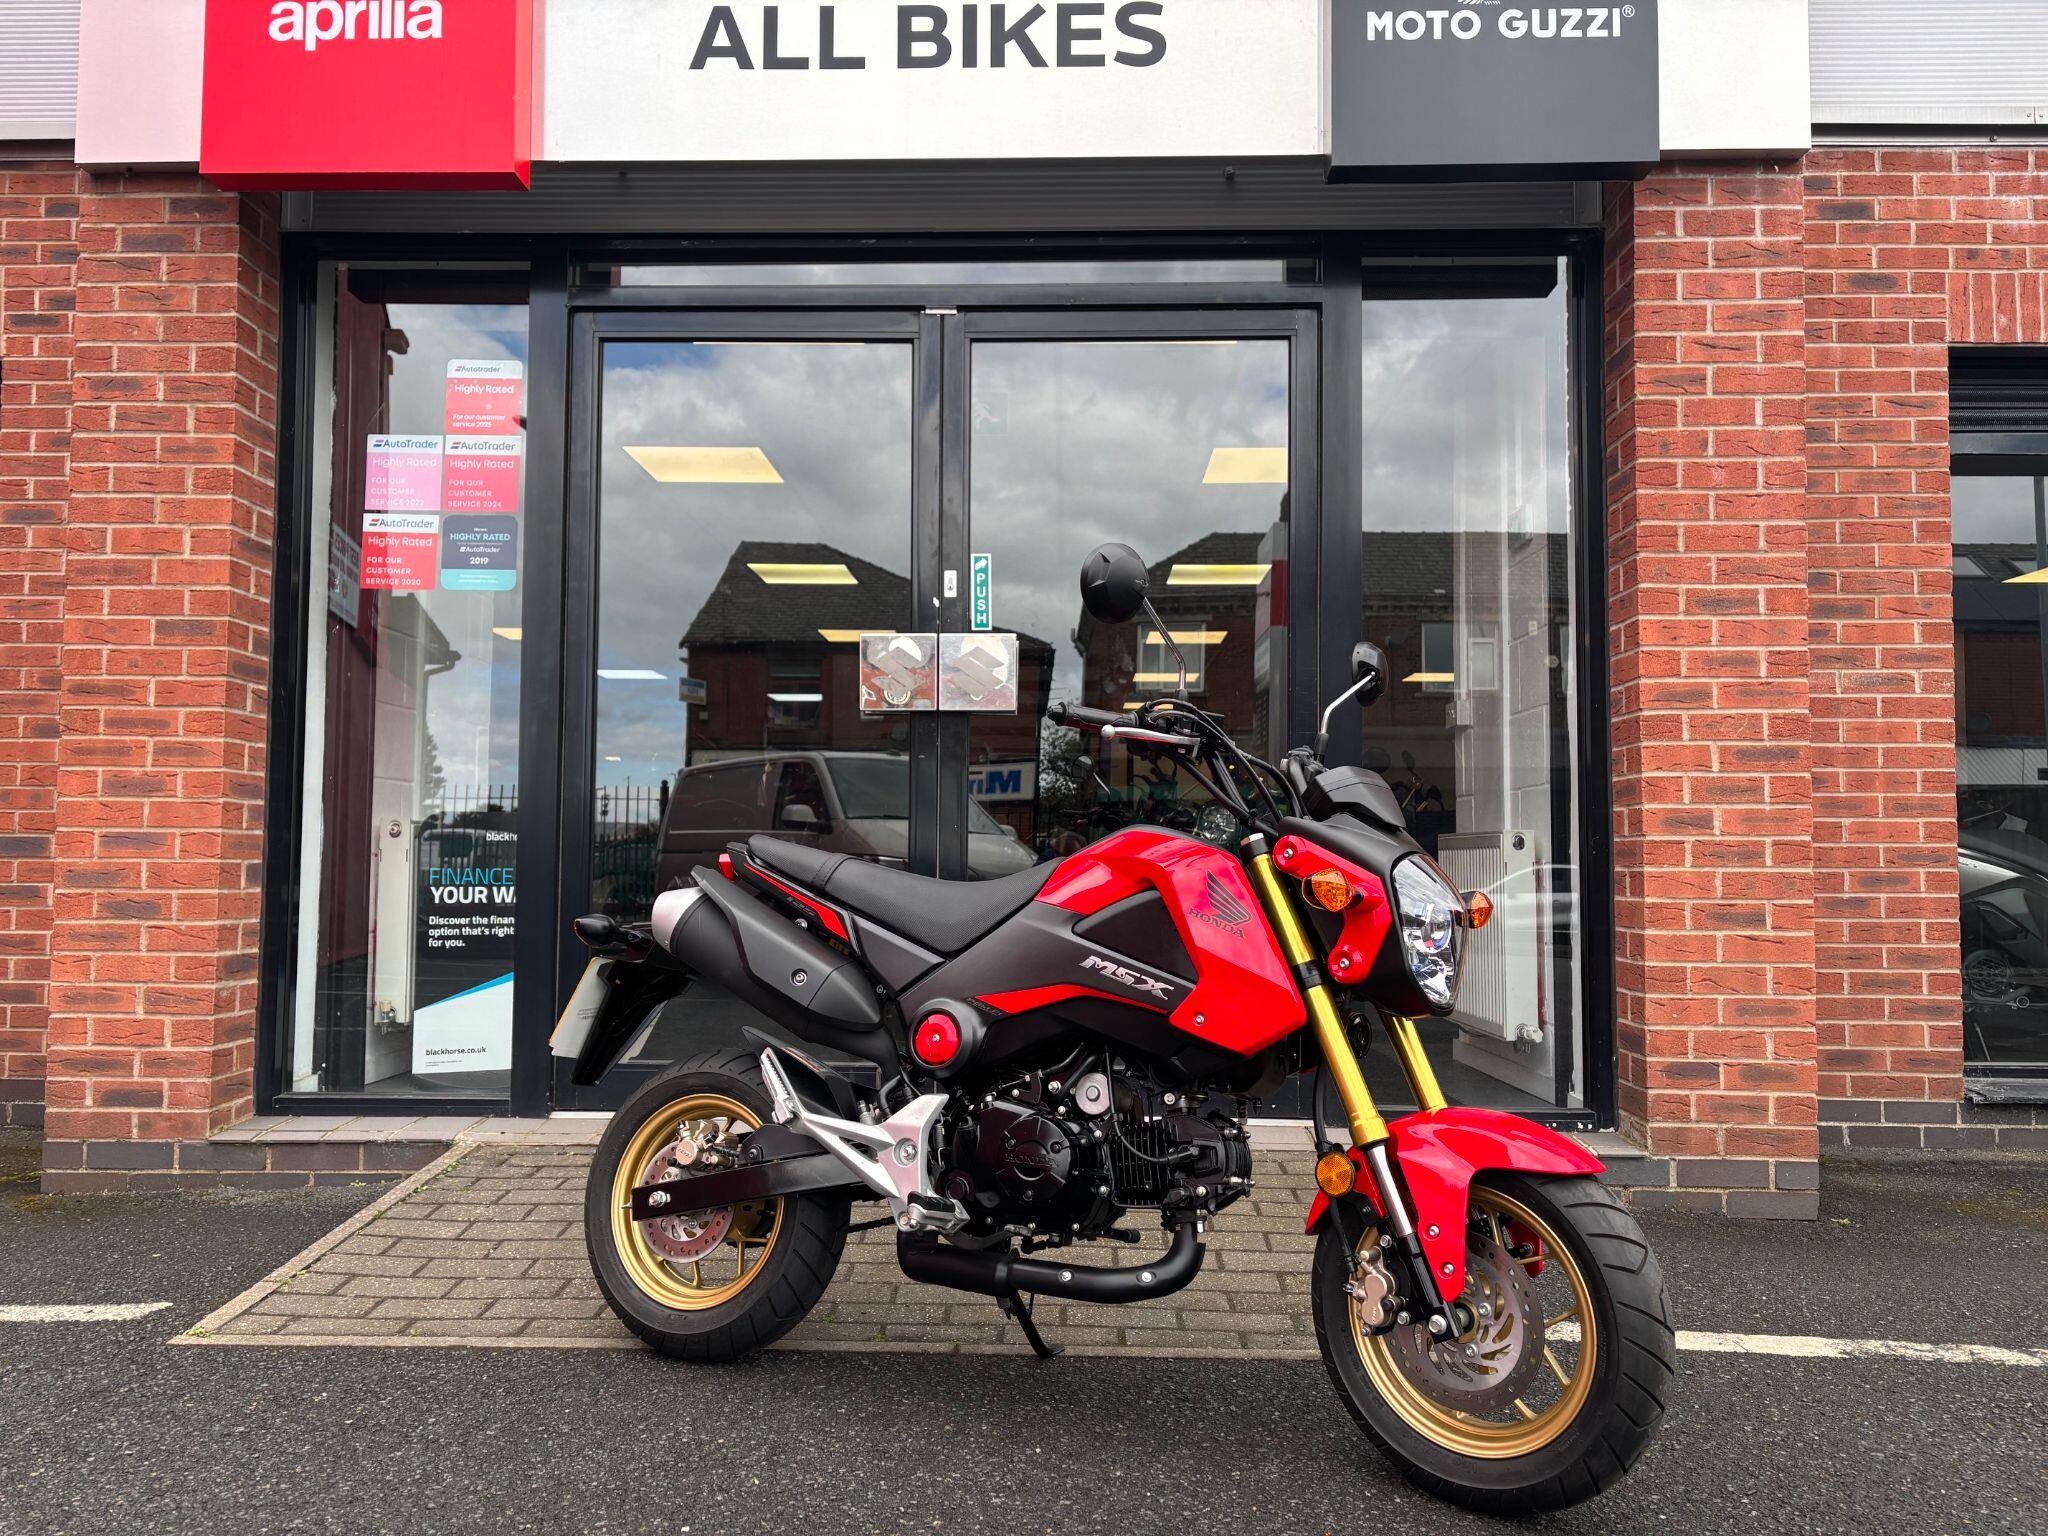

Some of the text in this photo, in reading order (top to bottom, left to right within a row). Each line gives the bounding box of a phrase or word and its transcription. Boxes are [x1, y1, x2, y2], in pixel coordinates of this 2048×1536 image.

[268, 0, 443, 51] aprilia
[1366, 10, 1482, 41] MOTO
[688, 1, 1167, 69] ALL BIKES
[454, 384, 514, 395] Highly Rated
[383, 440, 438, 449] AutoTrader
[460, 442, 516, 451] AutoTrader
[372, 456, 437, 468] Highly Rated
[449, 459, 514, 470] Highly Rated
[448, 489, 492, 497] CUSTOMER
[447, 500, 481, 508] SERVICE
[379, 519, 434, 528] AutoTrader
[368, 536, 433, 548] Highly Rated
[449, 532, 511, 541] HIGHLY RATED
[469, 557, 489, 565] 2019
[366, 567, 411, 575] CUSTOMER
[365, 577, 399, 585] SERVICE
[976, 572, 987, 625] PUSH
[429, 867, 514, 885] FINANCE
[430, 886, 516, 904] YOUR W
[428, 914, 515, 925] Discover the finan
[1188, 907, 1246, 939] HONDA
[428, 926, 515, 938] option that's right
[428, 938, 466, 949] for you.
[1078, 955, 1175, 1001] MSX
[425, 1046, 486, 1056] blackhorse.co.uk
